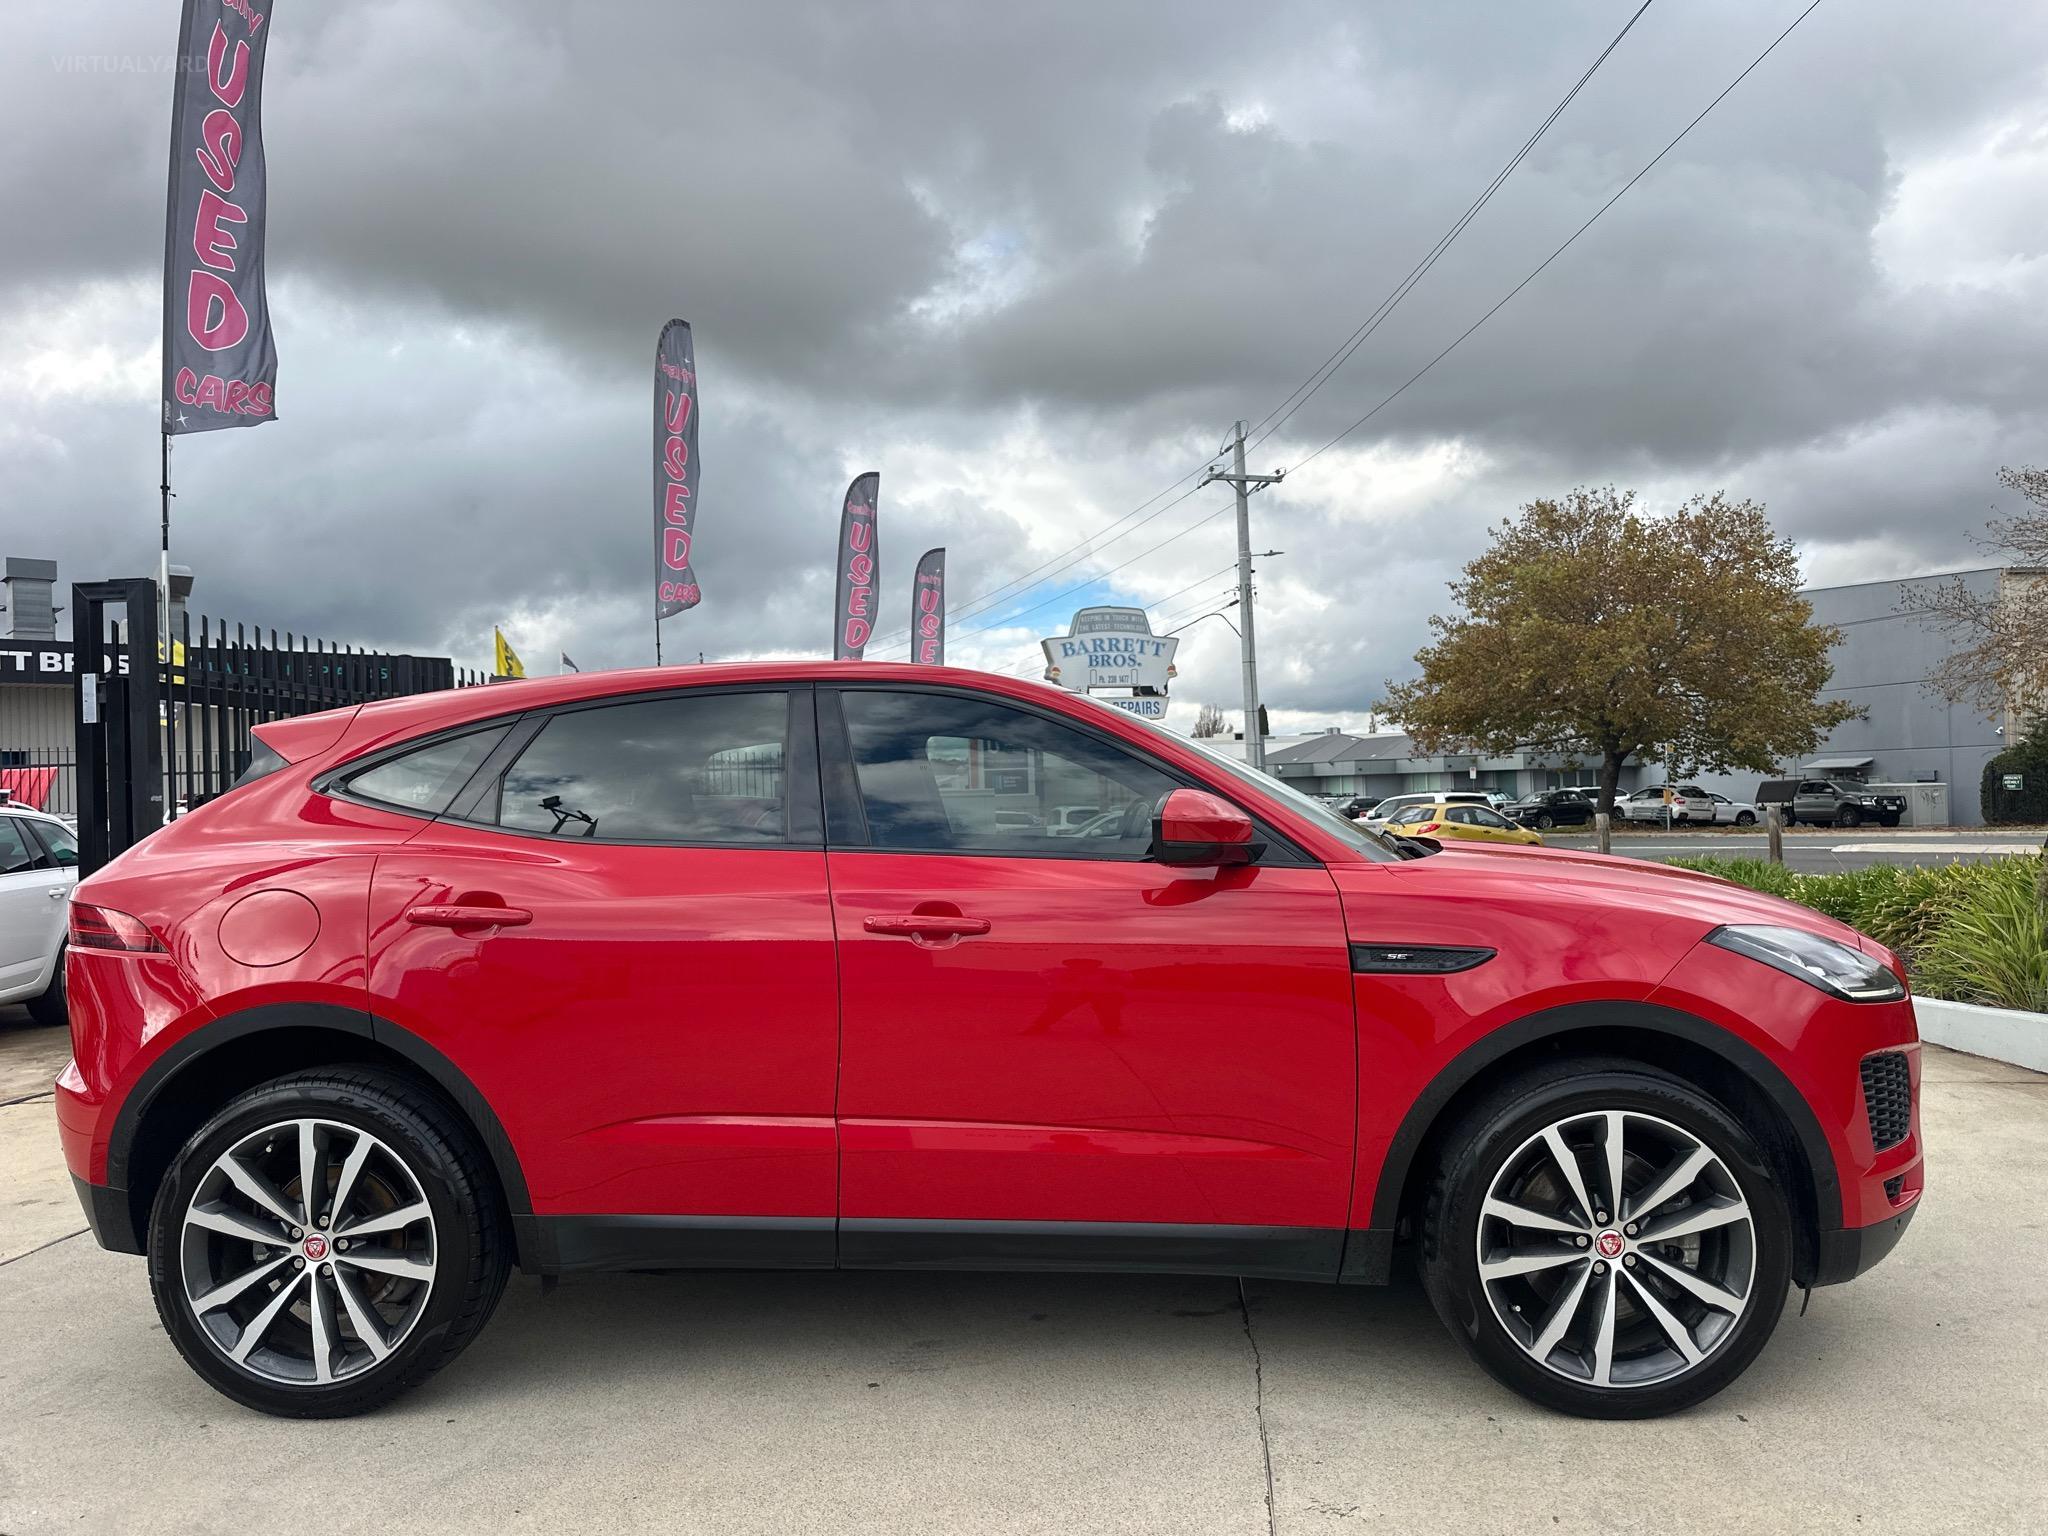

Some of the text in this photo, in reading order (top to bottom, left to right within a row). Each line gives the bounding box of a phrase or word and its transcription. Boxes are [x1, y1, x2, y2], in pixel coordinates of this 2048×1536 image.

[188, 19, 250, 351] USED
[175, 366, 274, 416] CARS
[663, 390, 692, 571] USED
[844, 522, 873, 648] USED
[1060, 637, 1167, 658] BARRETT
[1088, 653, 1142, 668] BROS.
